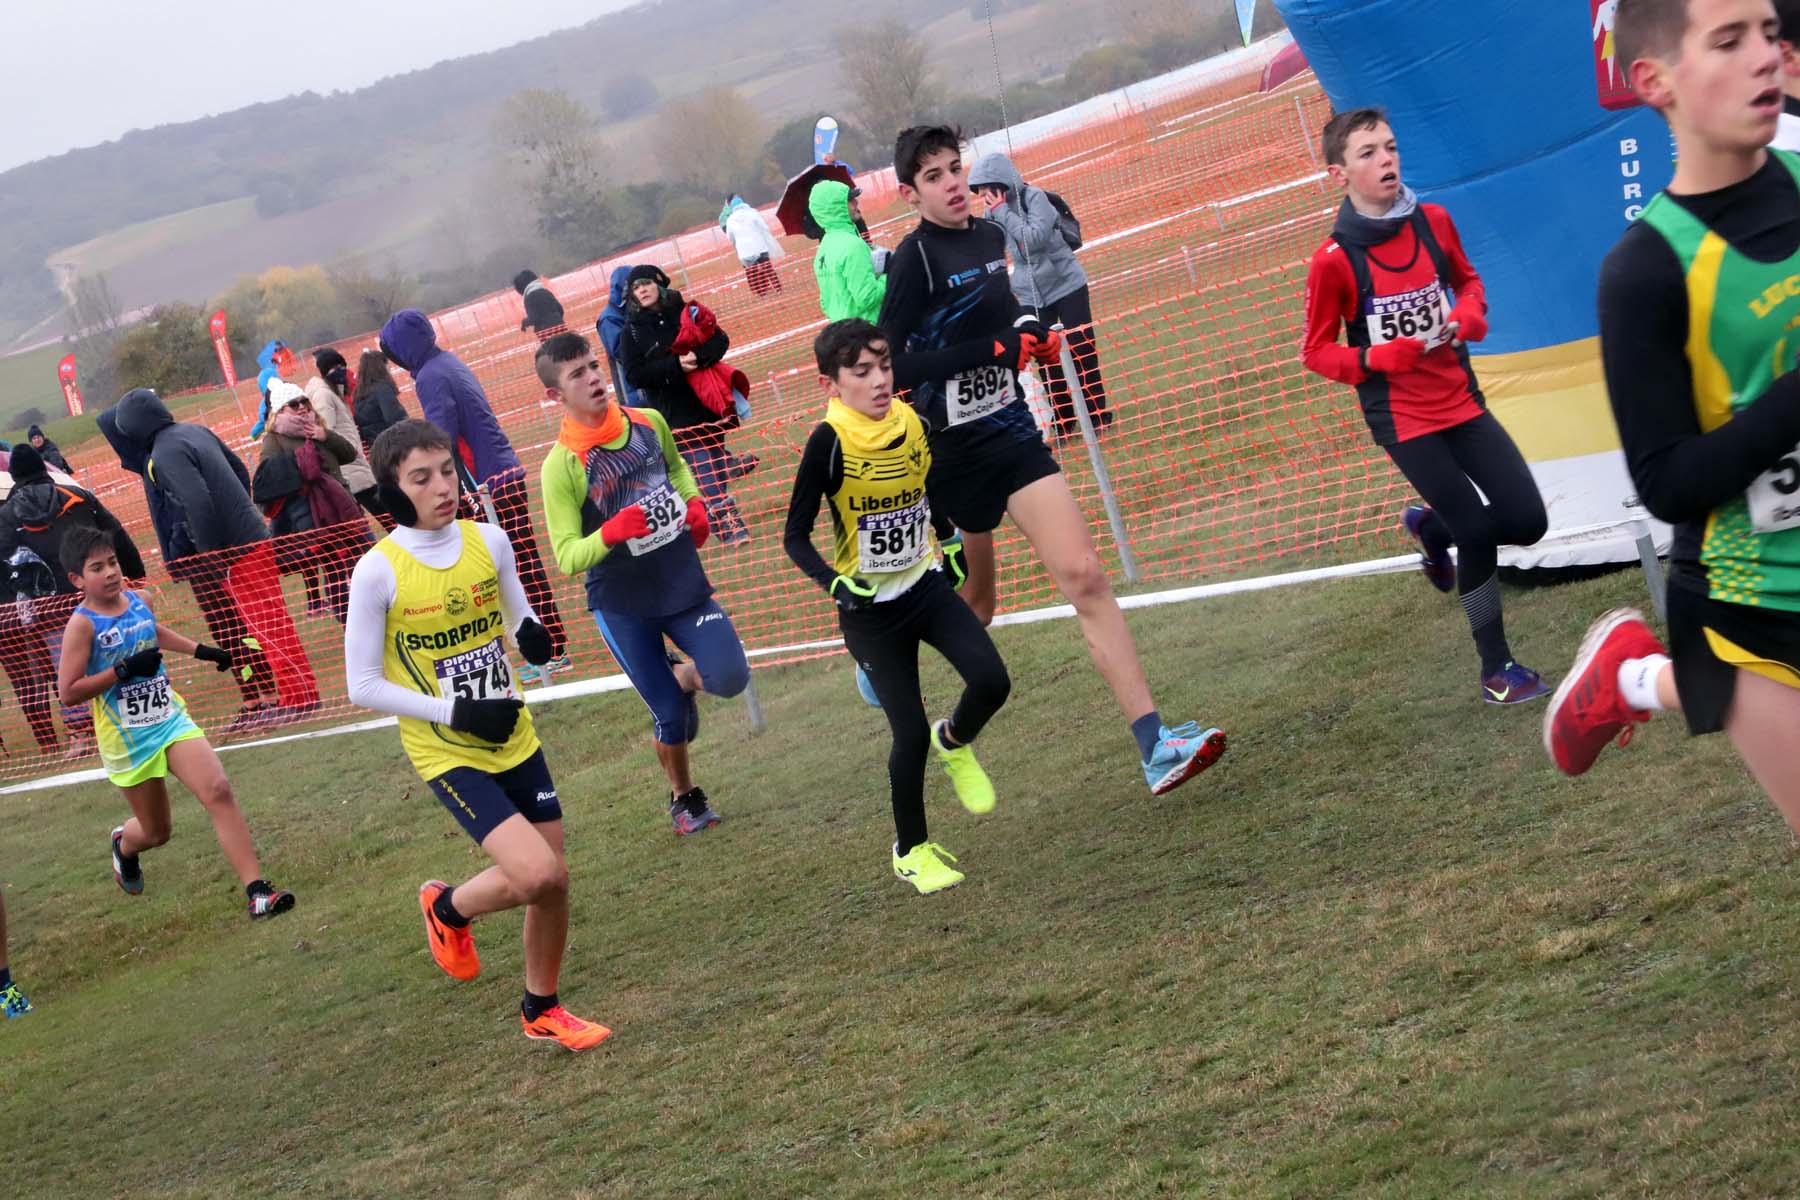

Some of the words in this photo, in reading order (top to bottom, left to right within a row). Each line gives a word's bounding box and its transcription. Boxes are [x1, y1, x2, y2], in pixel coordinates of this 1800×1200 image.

[1381, 298, 1444, 340] 5637
[958, 368, 1009, 405] 5692
[645, 498, 682, 532] 592
[870, 515, 926, 555] 5817
[868, 556, 913, 568] iberCaja
[403, 603, 443, 616] Alcampo
[453, 659, 510, 700] 5743
[127, 688, 170, 716] 5745
